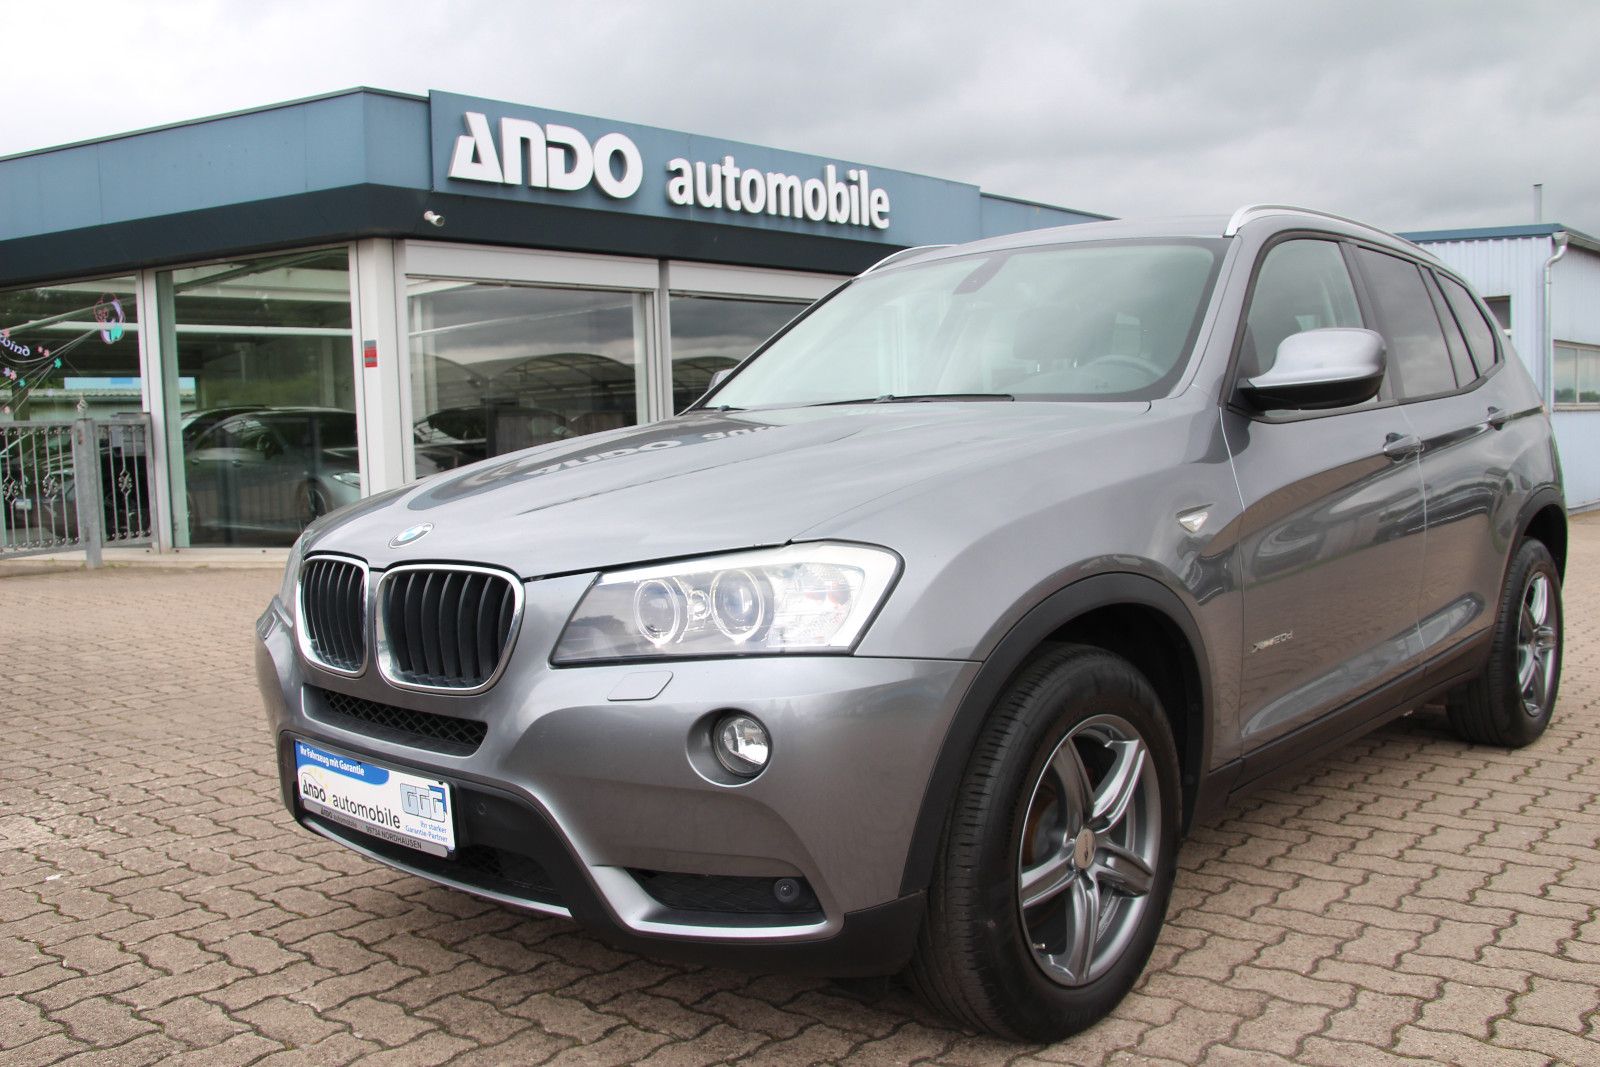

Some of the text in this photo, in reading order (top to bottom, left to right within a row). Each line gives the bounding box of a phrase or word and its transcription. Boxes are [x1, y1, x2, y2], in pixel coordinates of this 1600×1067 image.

[447, 110, 890, 230] ANDO automobile
[306, 747, 329, 767] Fahrzeug
[329, 758, 339, 769] mit
[339, 761, 365, 777] Garantie
[303, 779, 401, 829] ANDO automobile
[381, 830, 422, 850] NORDHAUSEN
[428, 822, 447, 834] starker
